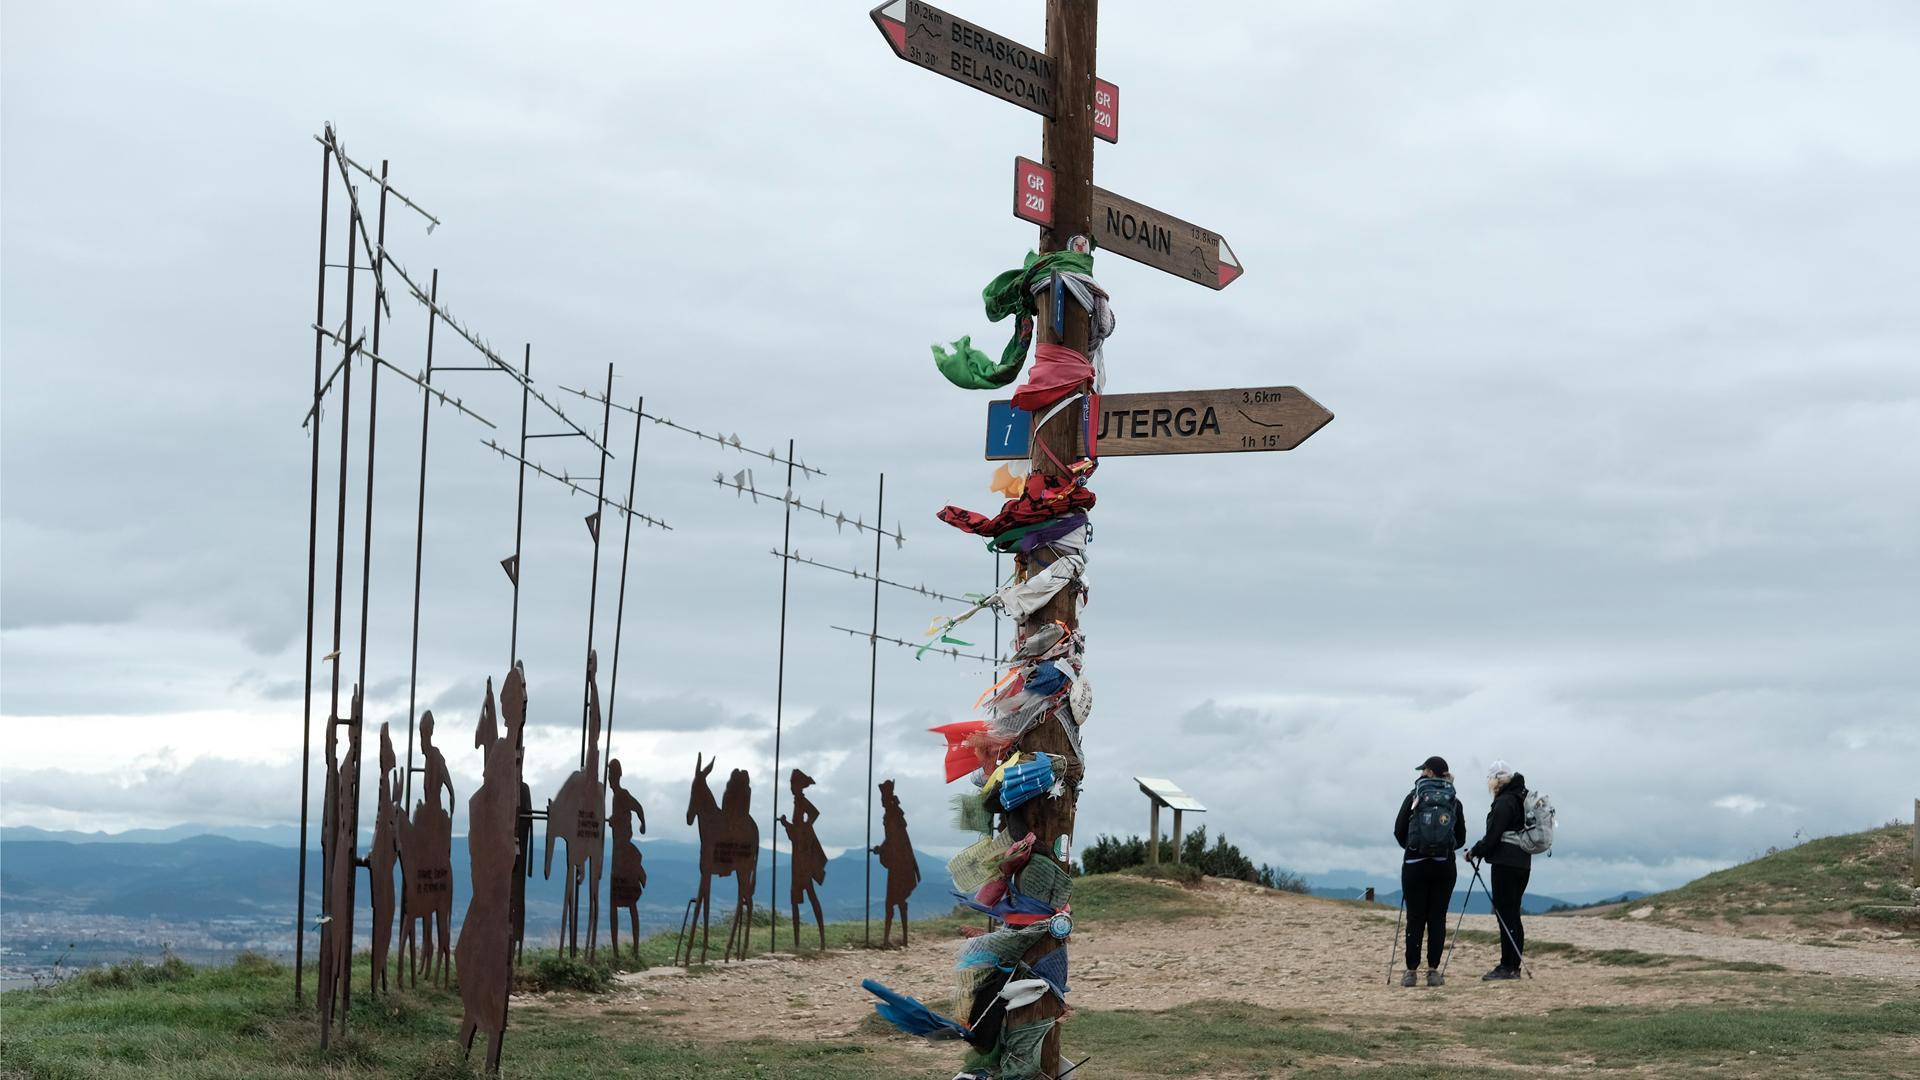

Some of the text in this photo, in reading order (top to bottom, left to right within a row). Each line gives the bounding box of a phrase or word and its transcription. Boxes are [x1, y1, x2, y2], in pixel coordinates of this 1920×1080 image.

[910, 46, 921, 61] 3h
[952, 21, 1053, 79] BERASKOAIN
[951, 50, 1052, 107] BELASCOAIN
[1095, 91, 1111, 108] GR
[1094, 109, 1111, 128] 220
[1027, 173, 1045, 192] GR
[1025, 193, 1045, 213] 220
[1106, 207, 1171, 256] NOAIN
[1242, 391, 1281, 404] 3,6km
[1241, 435, 1256, 447] 1h
